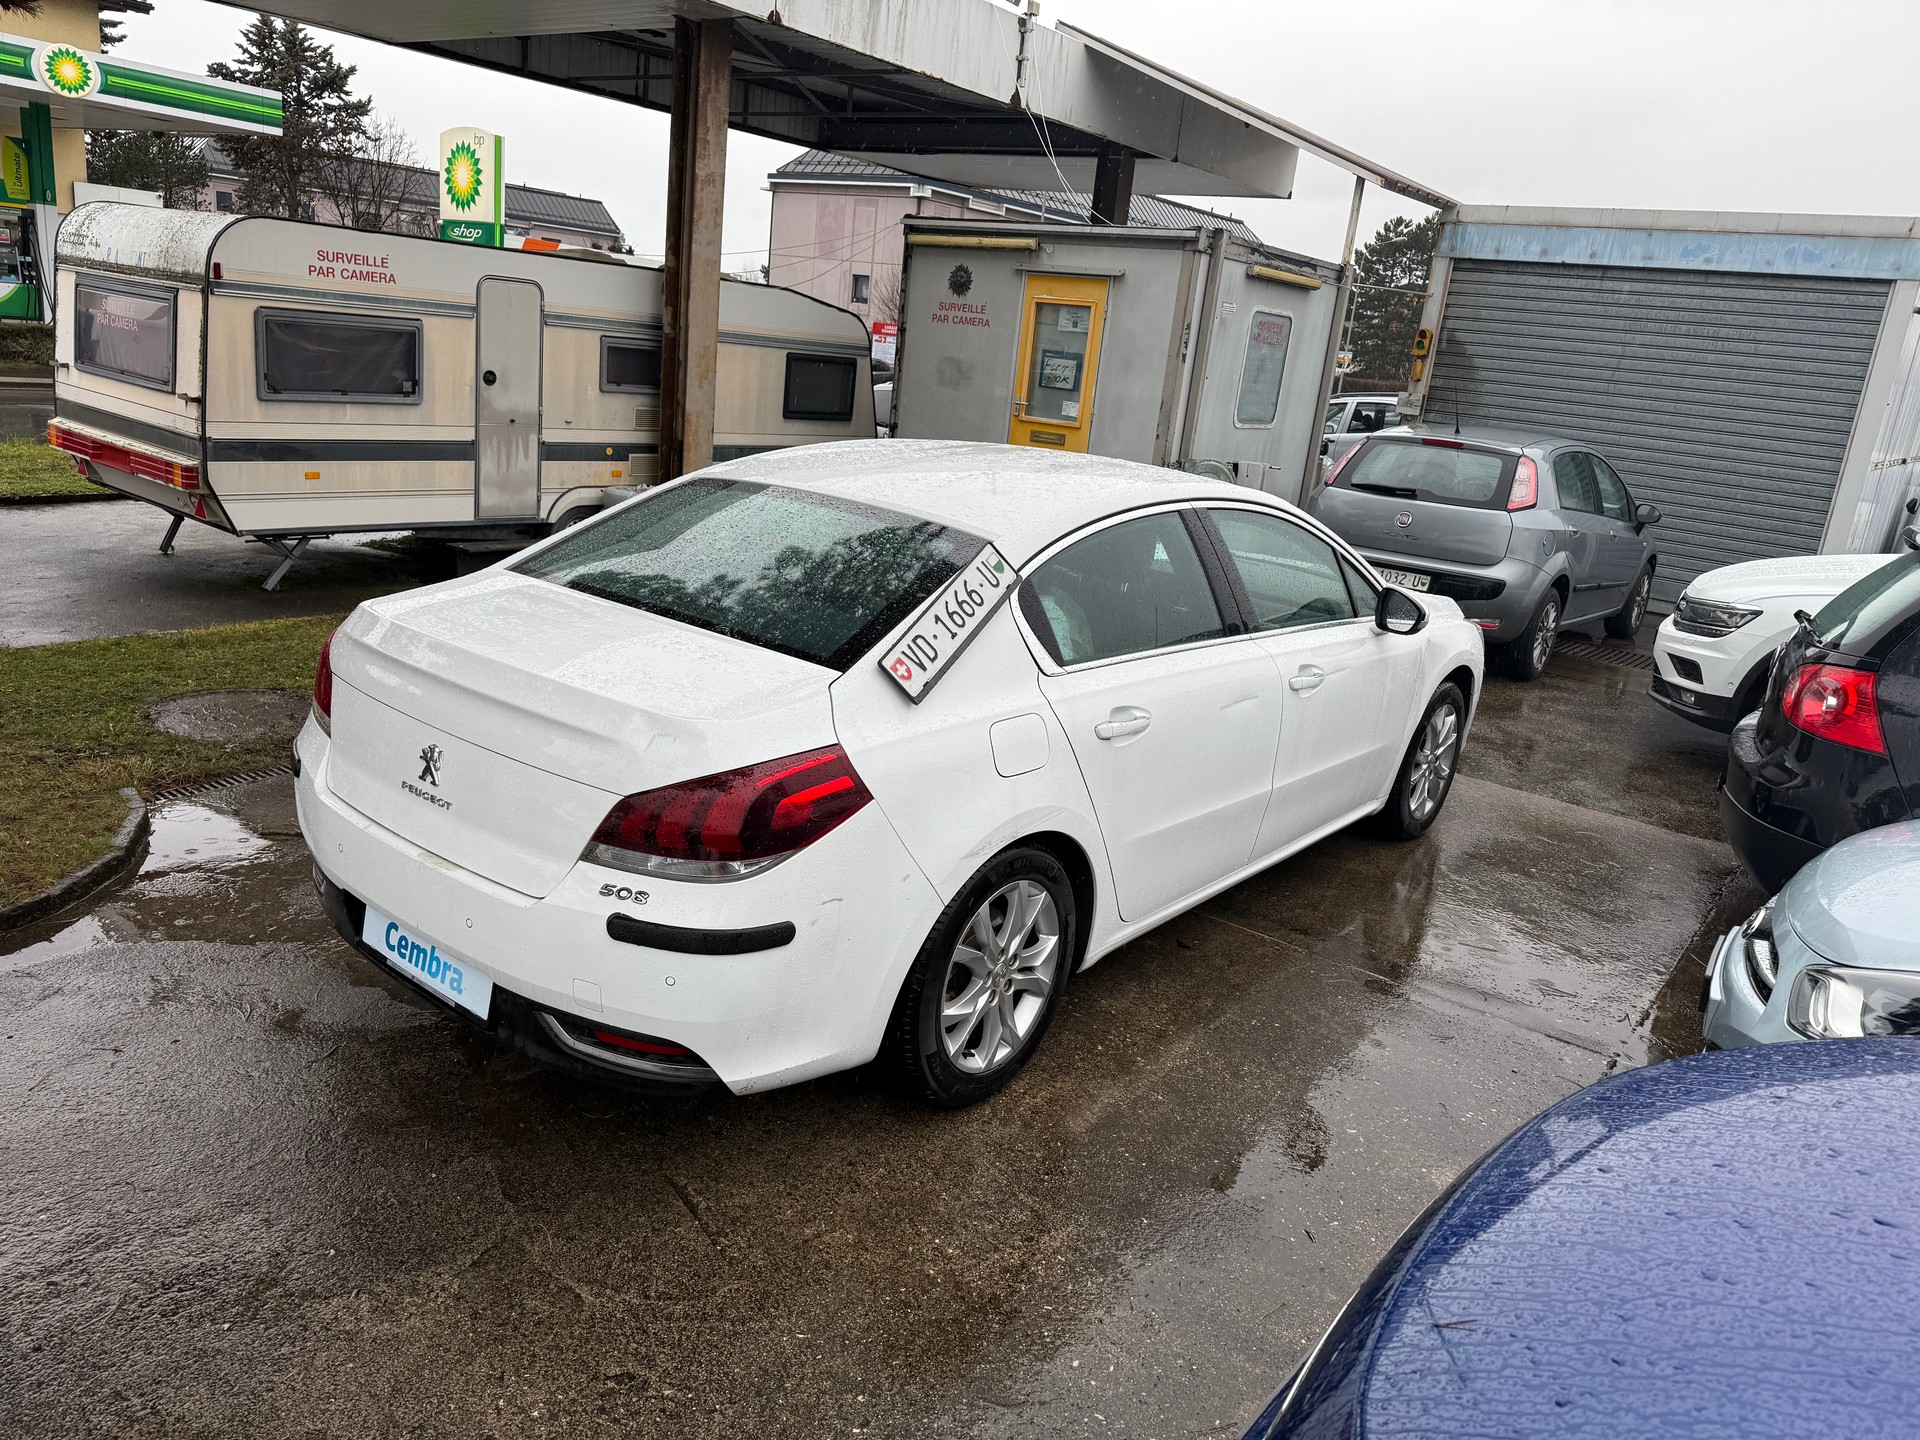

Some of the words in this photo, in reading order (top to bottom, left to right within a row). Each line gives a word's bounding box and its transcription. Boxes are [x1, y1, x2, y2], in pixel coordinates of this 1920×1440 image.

[473, 132, 485, 149] bp
[453, 223, 482, 241] shop
[317, 249, 390, 269] SURVEILLÉ
[308, 264, 336, 279] PAR
[340, 268, 397, 285] CAMERA
[97, 313, 109, 326] PAR
[110, 315, 138, 332] CAMERA
[931, 313, 949, 324] PAR
[952, 315, 990, 328] CAMERA
[401, 780, 453, 810] PEUGEOT
[599, 883, 650, 905] 508
[385, 921, 464, 995] Cembra
